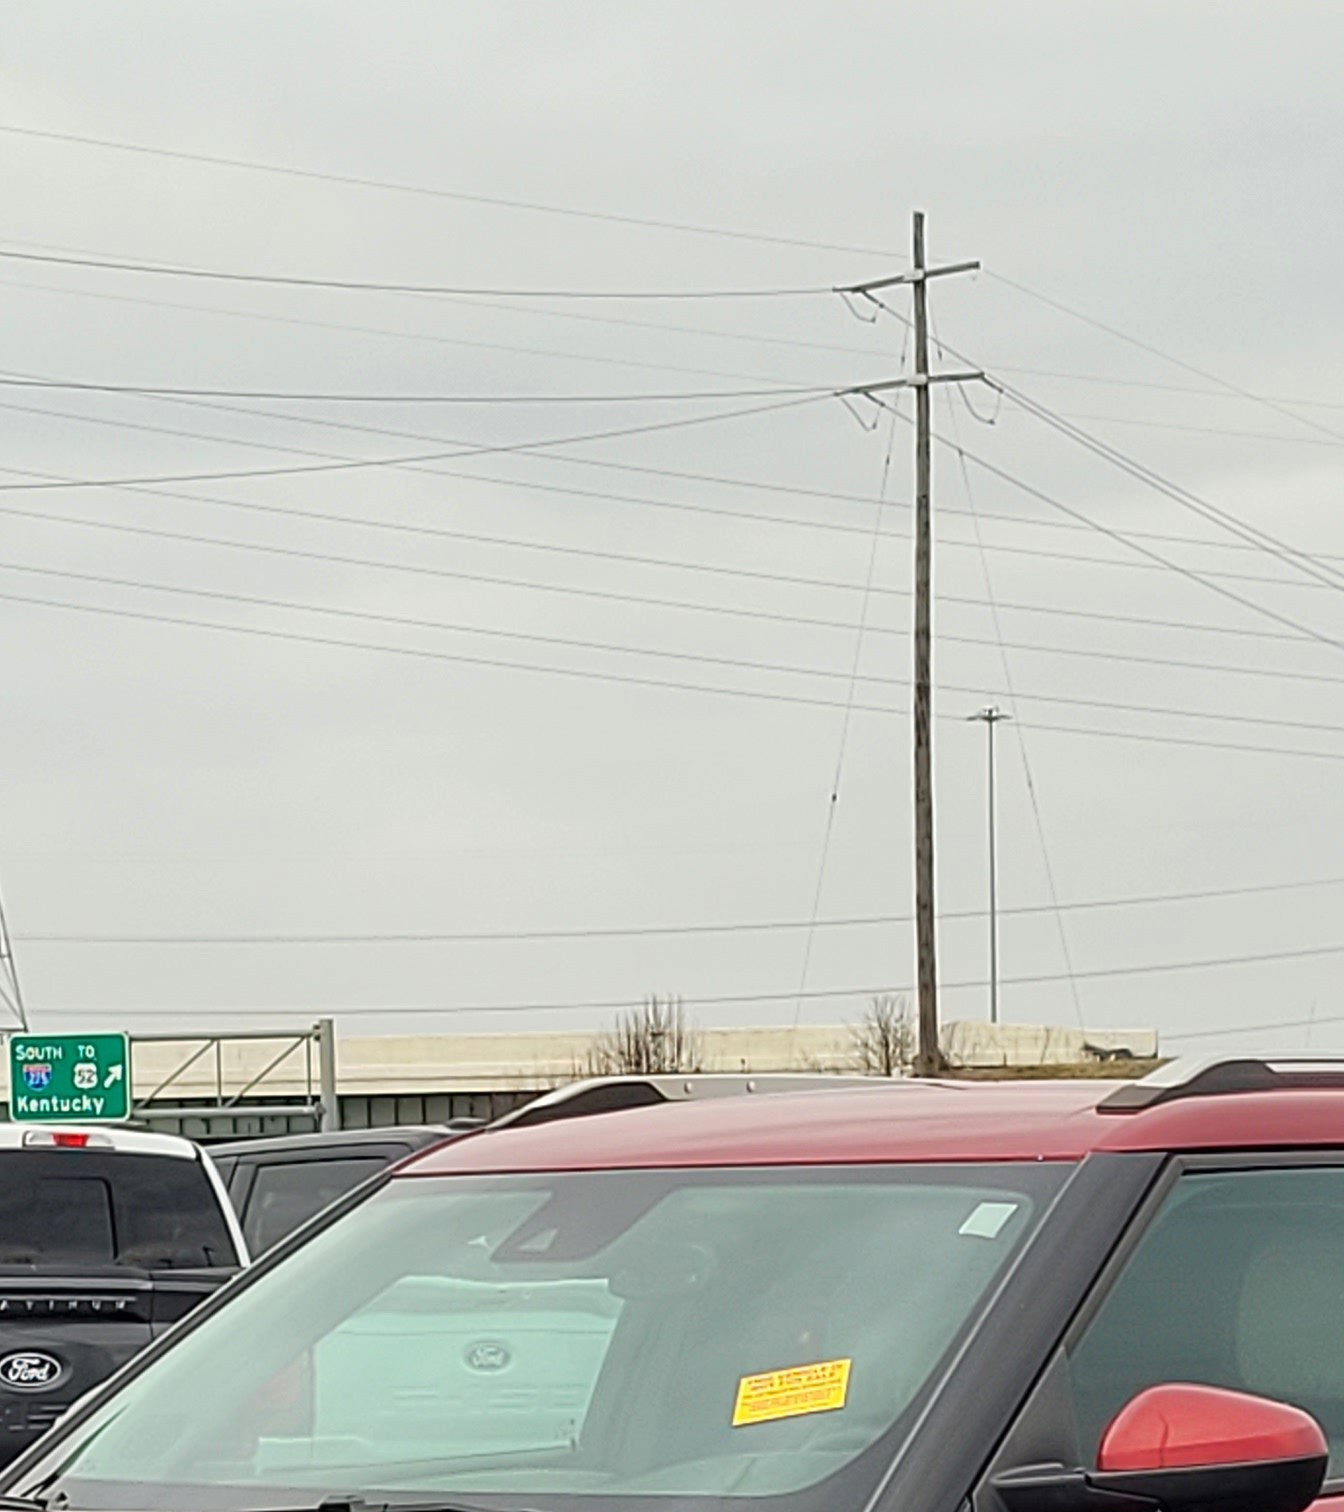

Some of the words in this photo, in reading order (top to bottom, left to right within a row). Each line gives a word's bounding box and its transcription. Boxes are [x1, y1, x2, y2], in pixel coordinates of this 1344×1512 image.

[16, 1044, 62, 1060] SOUTH
[77, 1044, 96, 1059] TO
[77, 1068, 96, 1085] 52
[16, 1094, 105, 1116] Kentucky
[8, 1358, 50, 1381] Ford
